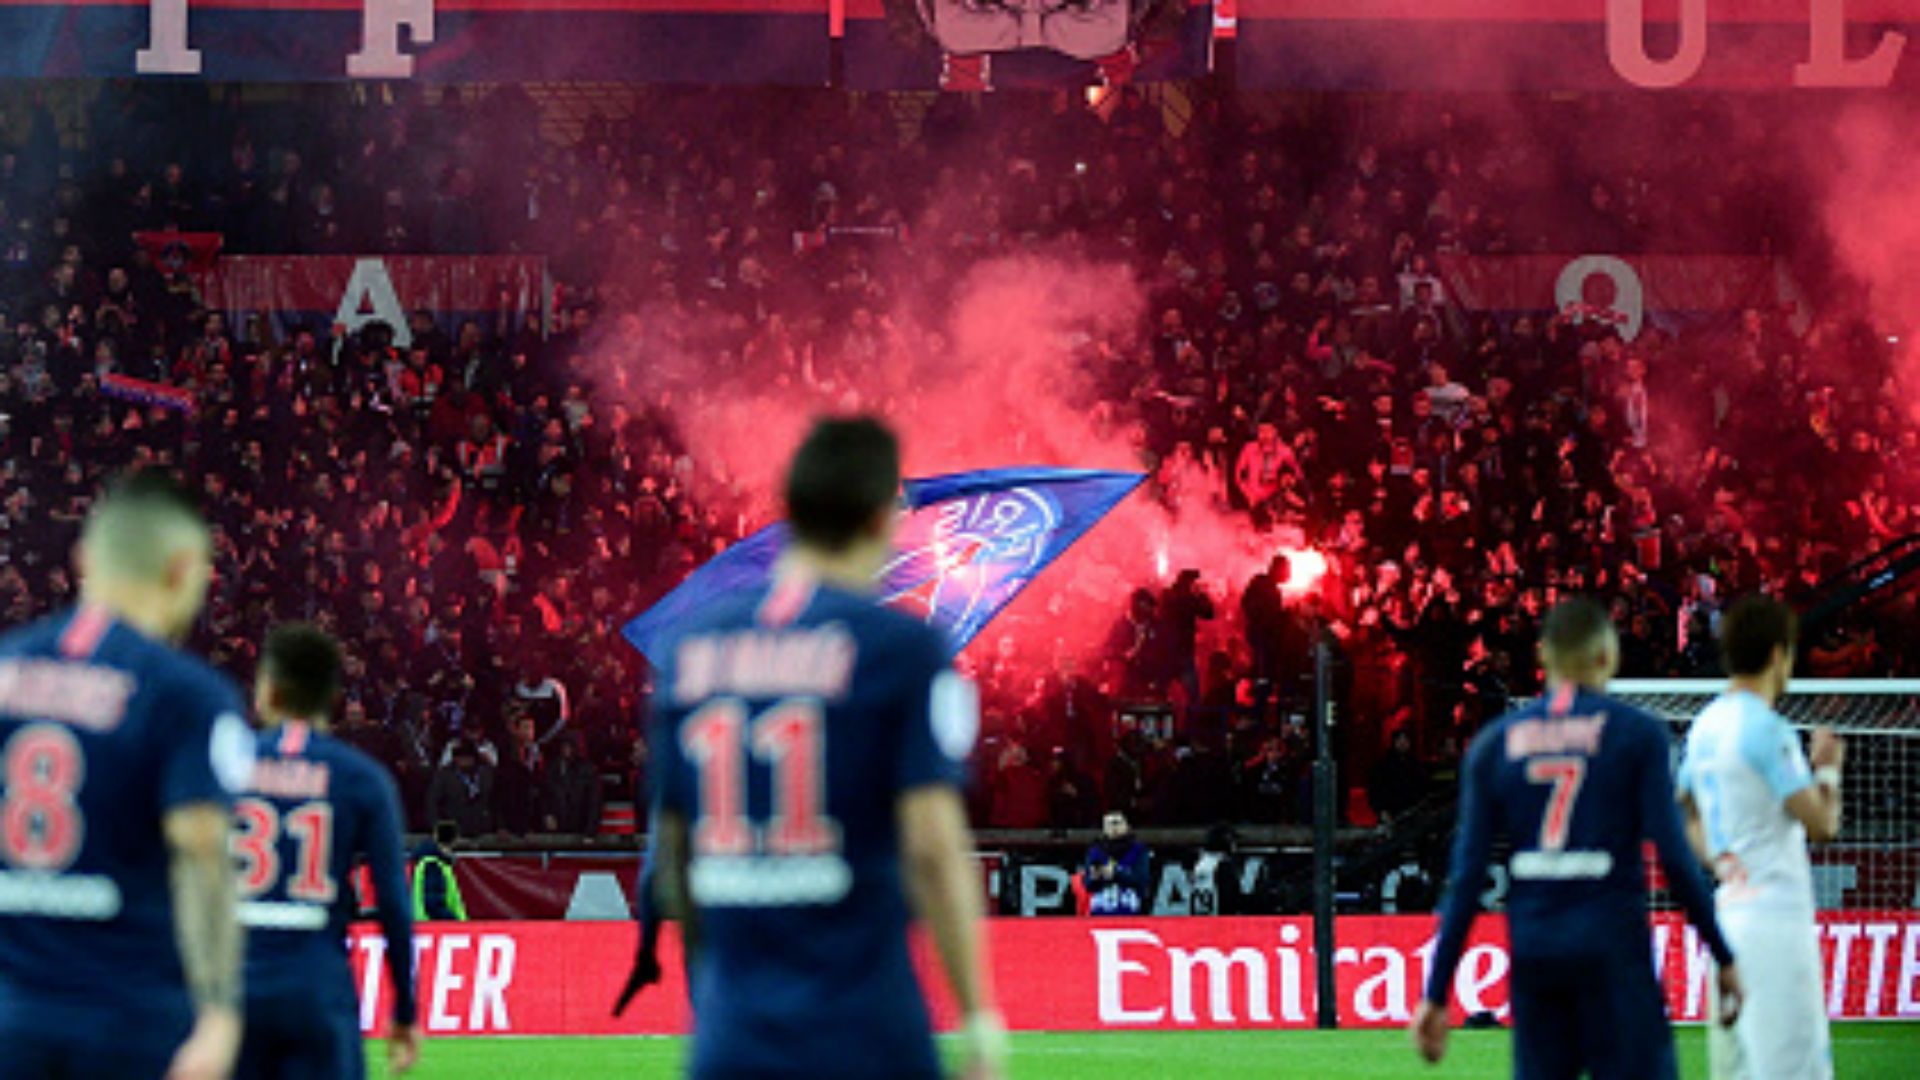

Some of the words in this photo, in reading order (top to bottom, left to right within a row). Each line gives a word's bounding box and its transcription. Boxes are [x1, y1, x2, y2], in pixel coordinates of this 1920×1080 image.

[330, 256, 413, 365] A
[0, 720, 84, 872] 8
[680, 697, 846, 858] 11
[1525, 757, 1587, 851] 7
[230, 797, 338, 903] 31
[1091, 924, 1511, 1023] Emirate
